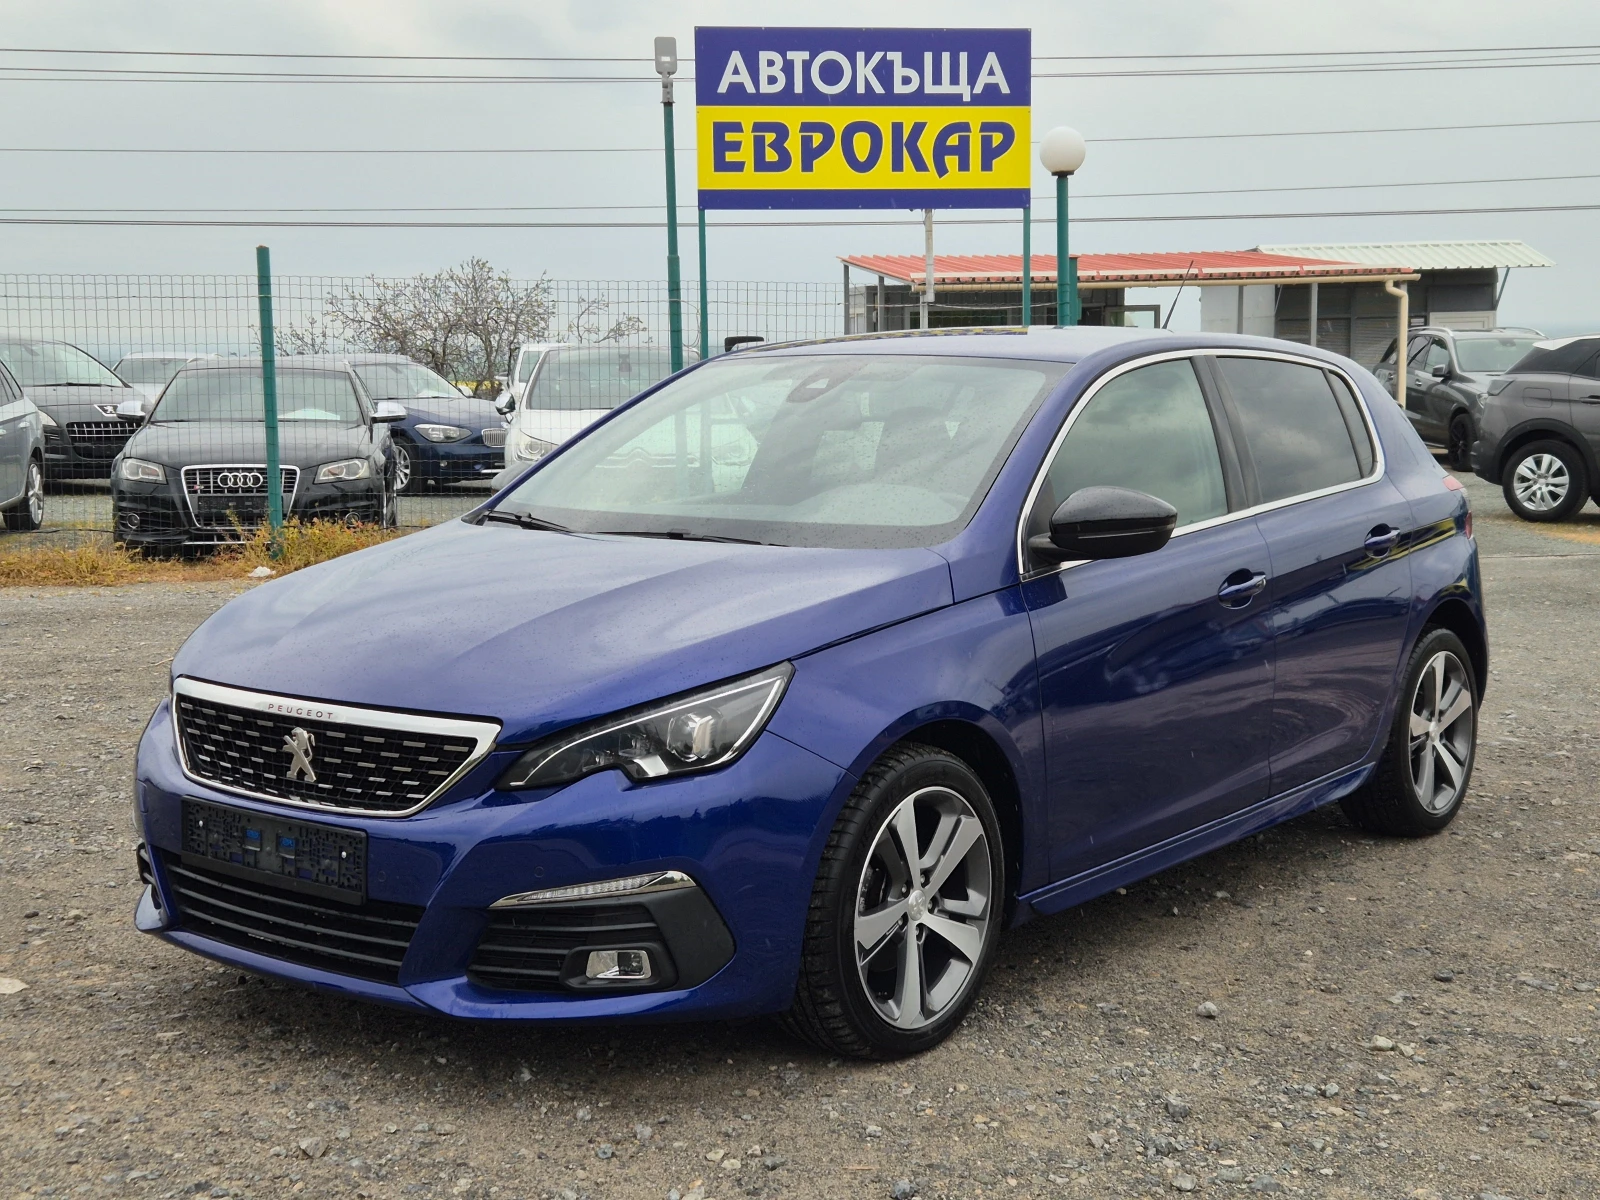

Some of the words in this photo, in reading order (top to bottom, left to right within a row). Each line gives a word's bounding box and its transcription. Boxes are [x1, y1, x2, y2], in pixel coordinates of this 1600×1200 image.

[717, 50, 1010, 101] АВТОКЪЩА
[712, 120, 1016, 179] ЕВРОКАР
[267, 703, 333, 719] PEUGEOT
